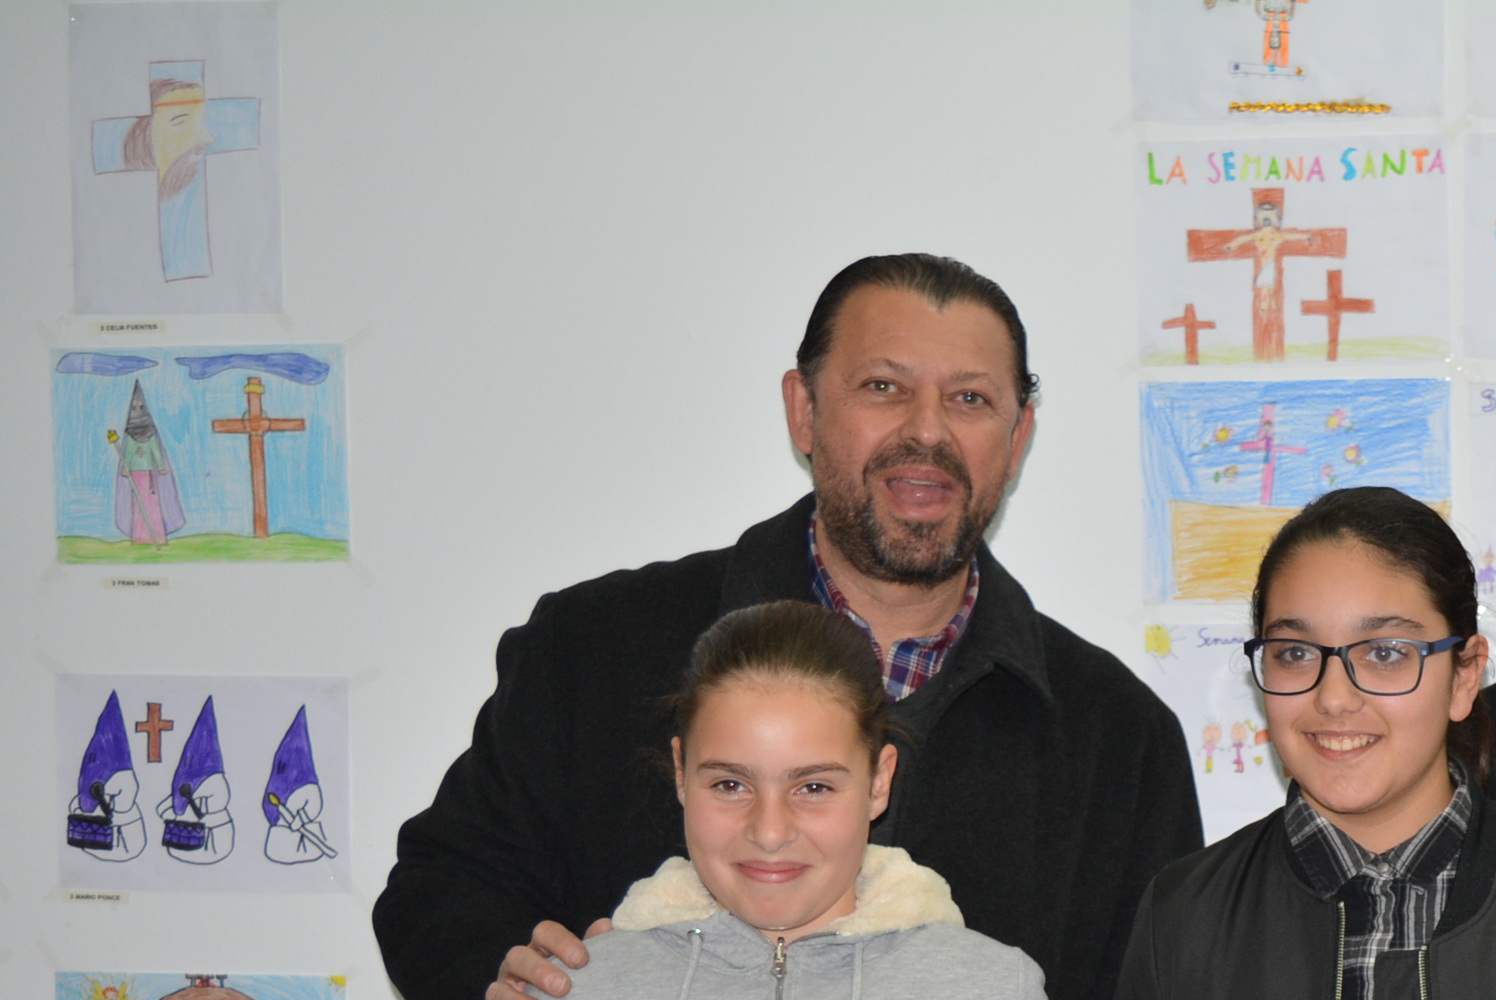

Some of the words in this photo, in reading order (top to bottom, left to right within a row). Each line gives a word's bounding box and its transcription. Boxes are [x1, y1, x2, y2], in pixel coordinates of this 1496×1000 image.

[1147, 152, 1188, 186] LA
[1207, 151, 1326, 184] SEMANA
[1340, 147, 1446, 182] SANTA
[106, 324, 125, 332] CELIA
[126, 323, 158, 331] FUENTES
[117, 579, 136, 587] FRAN
